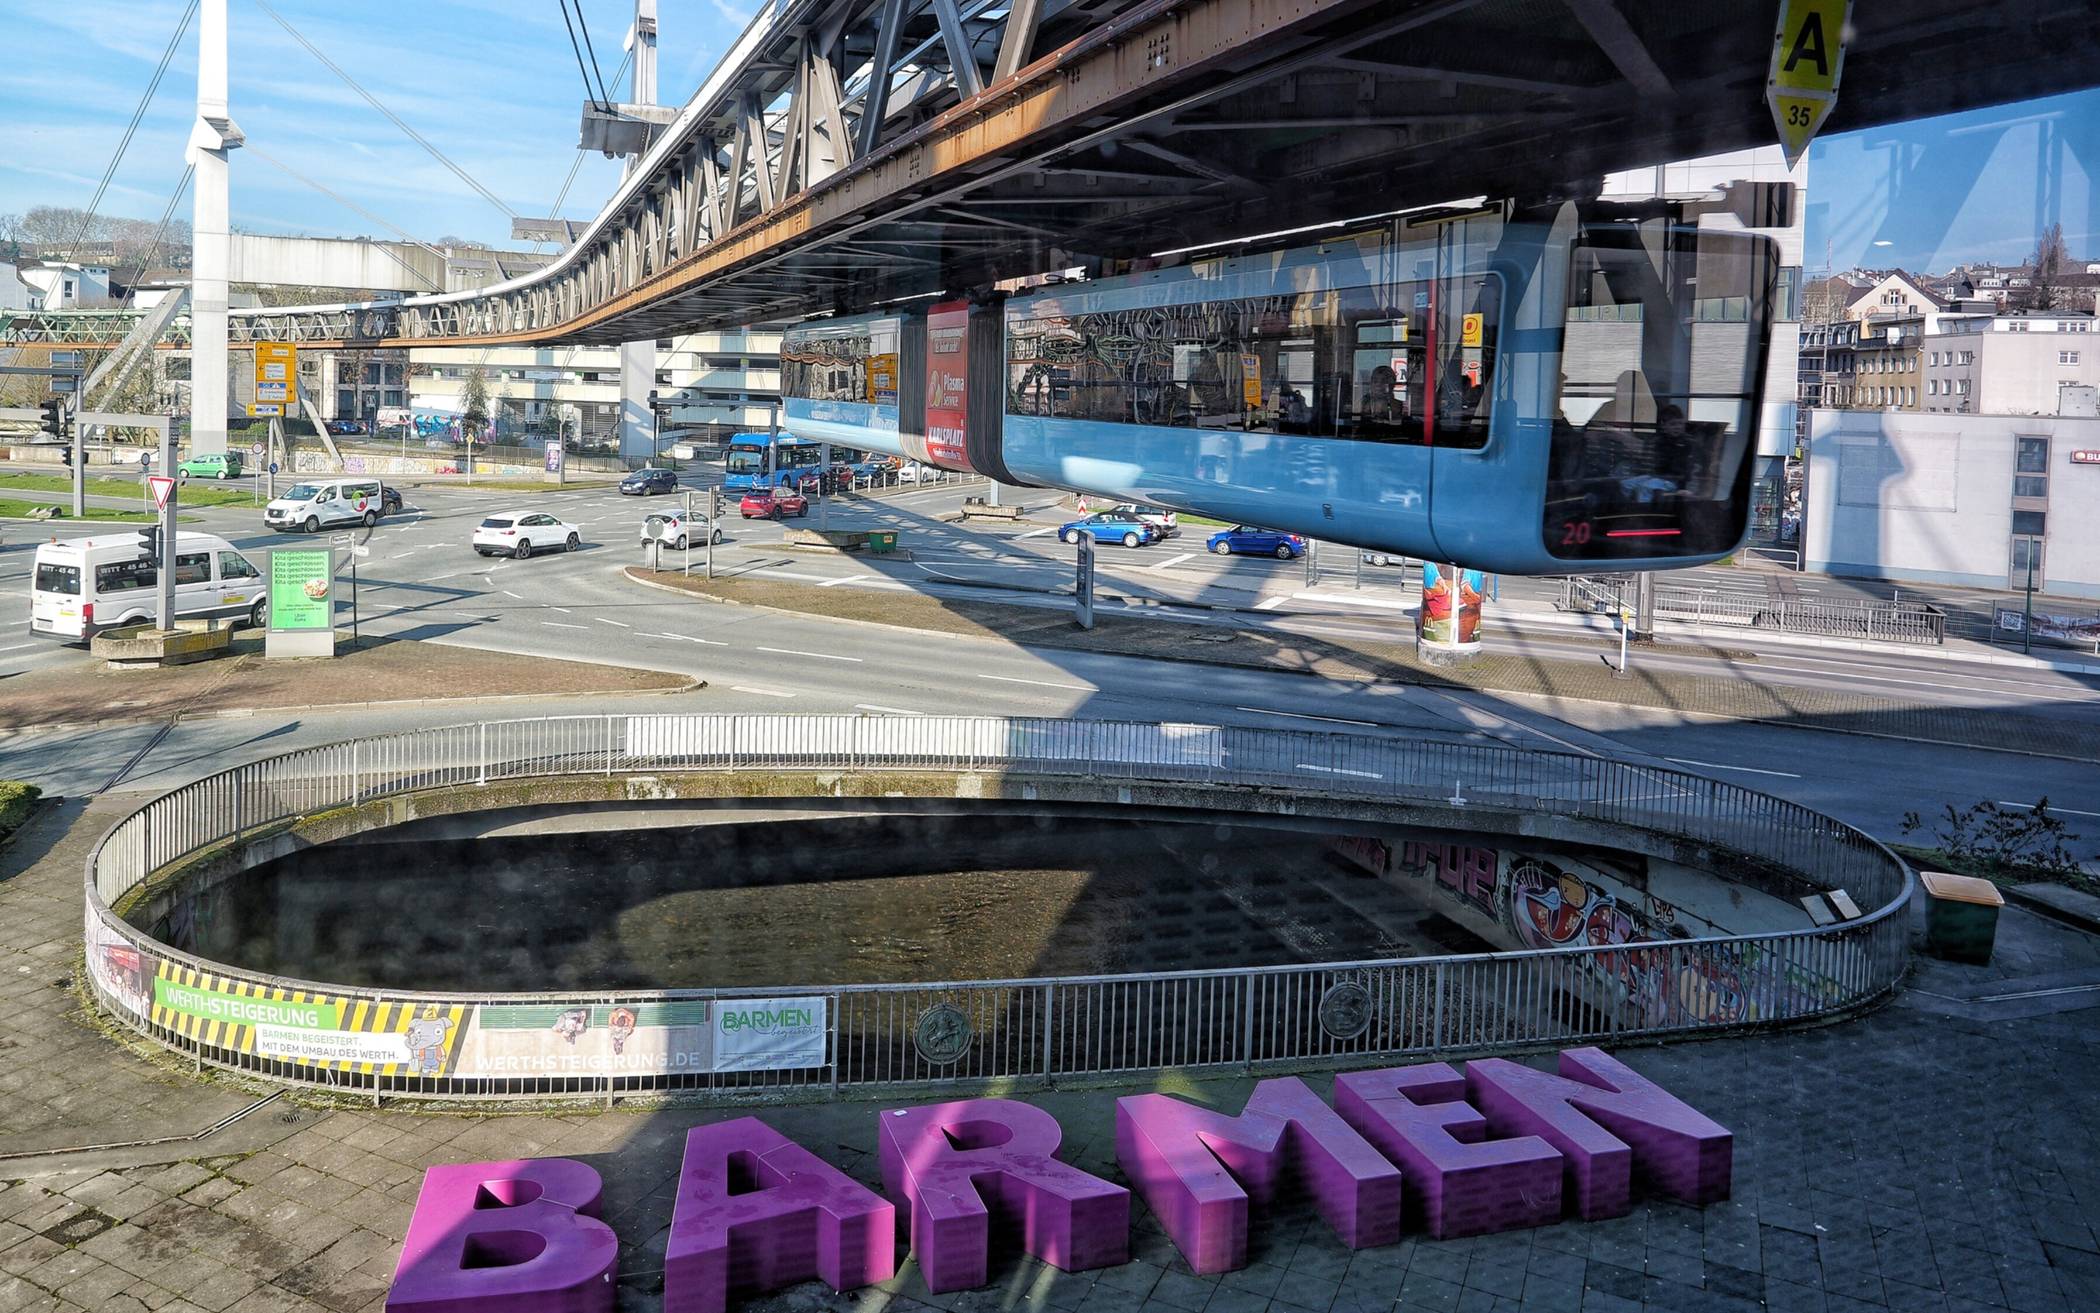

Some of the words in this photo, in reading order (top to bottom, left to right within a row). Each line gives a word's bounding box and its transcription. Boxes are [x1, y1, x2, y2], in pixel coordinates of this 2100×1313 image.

[1783, 12, 1828, 76] A
[1788, 105, 1811, 127] 35
[943, 372, 965, 391] Plasma
[927, 426, 964, 448] KARLSPLATZ
[1562, 522, 1591, 545] 20
[100, 565, 120, 574] WITT
[165, 986, 319, 1027] WERTHSTEIGERUNG
[721, 1008, 812, 1030] BARMEN
[262, 1029, 300, 1041] BARMEN
[302, 1033, 362, 1047] BEGEISTERT.
[262, 1042, 278, 1051] MIT
[280, 1043, 300, 1054] DEM
[302, 1046, 336, 1057] UMBAU
[338, 1049, 358, 1058] DES
[359, 1050, 399, 1060] WERTH.
[476, 1051, 701, 1070] WERTHSTEIGERUNG.DE
[384, 1046, 1733, 1313] BARMEN
